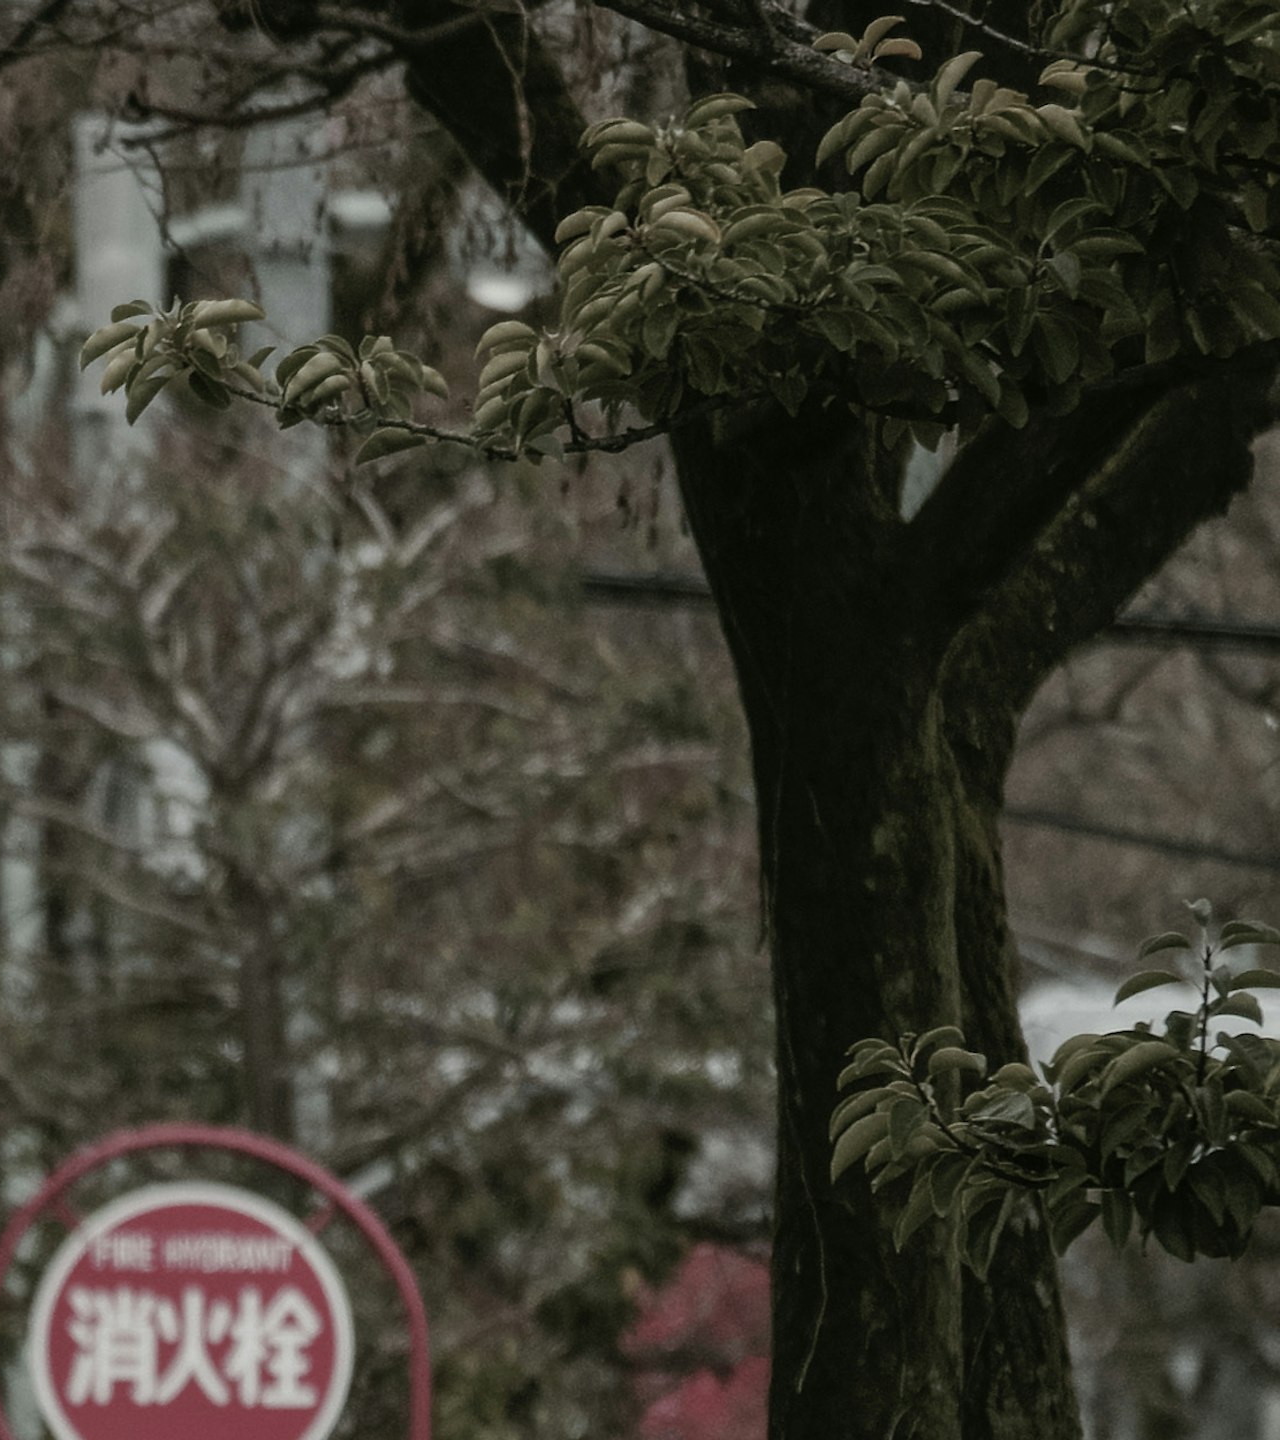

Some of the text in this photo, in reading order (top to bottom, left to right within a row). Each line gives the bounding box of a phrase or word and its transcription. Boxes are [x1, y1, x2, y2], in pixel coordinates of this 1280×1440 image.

[94, 1234, 153, 1272] FIRE
[65, 1283, 324, 1410] 消火栓
